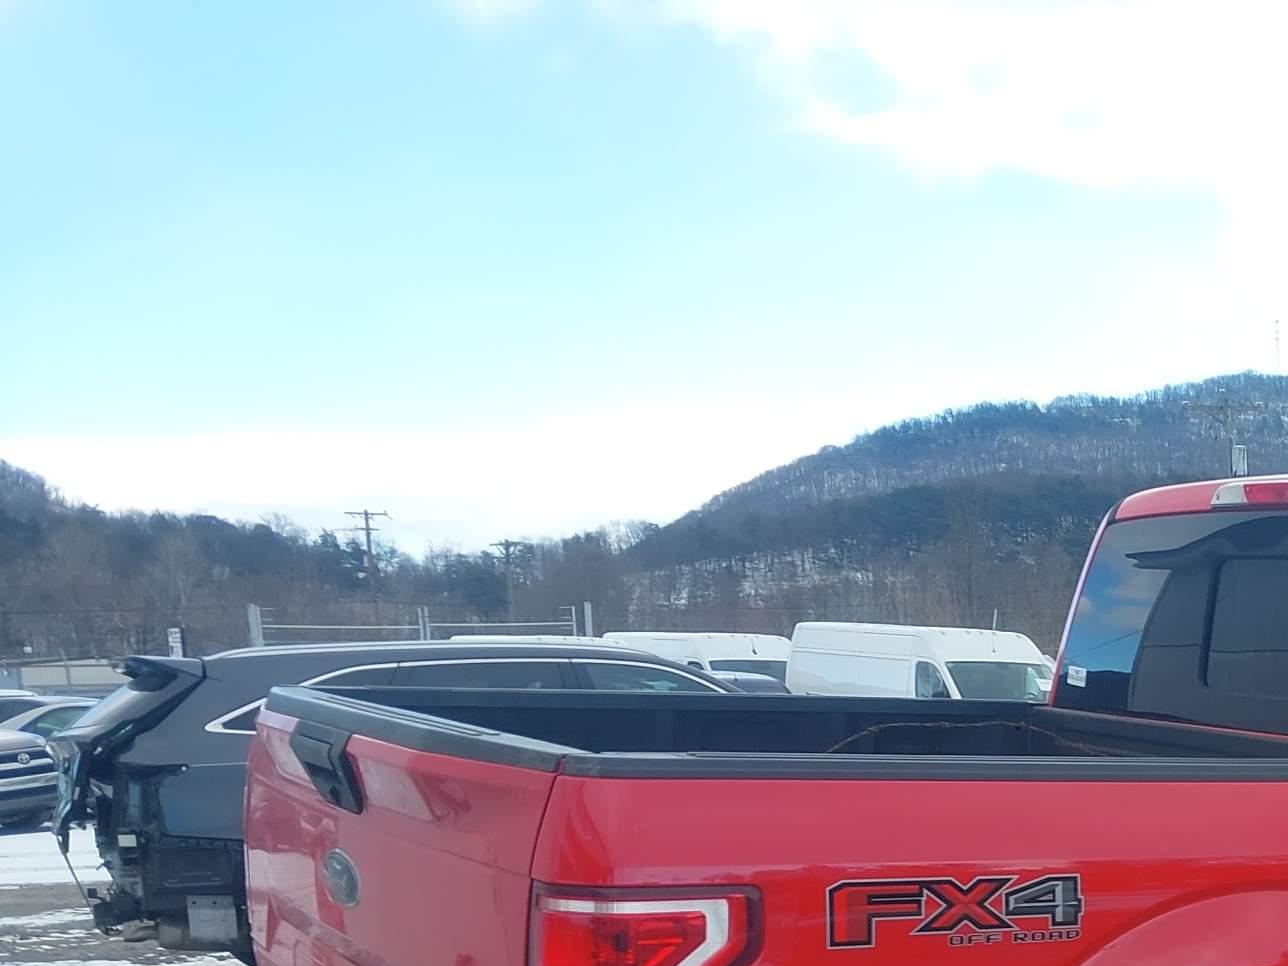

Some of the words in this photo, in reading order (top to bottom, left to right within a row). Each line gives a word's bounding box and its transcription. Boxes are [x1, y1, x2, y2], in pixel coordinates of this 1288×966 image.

[826, 873, 1084, 949] FX4
[949, 933, 1002, 947] OFF
[1012, 928, 1081, 945] ROAD
